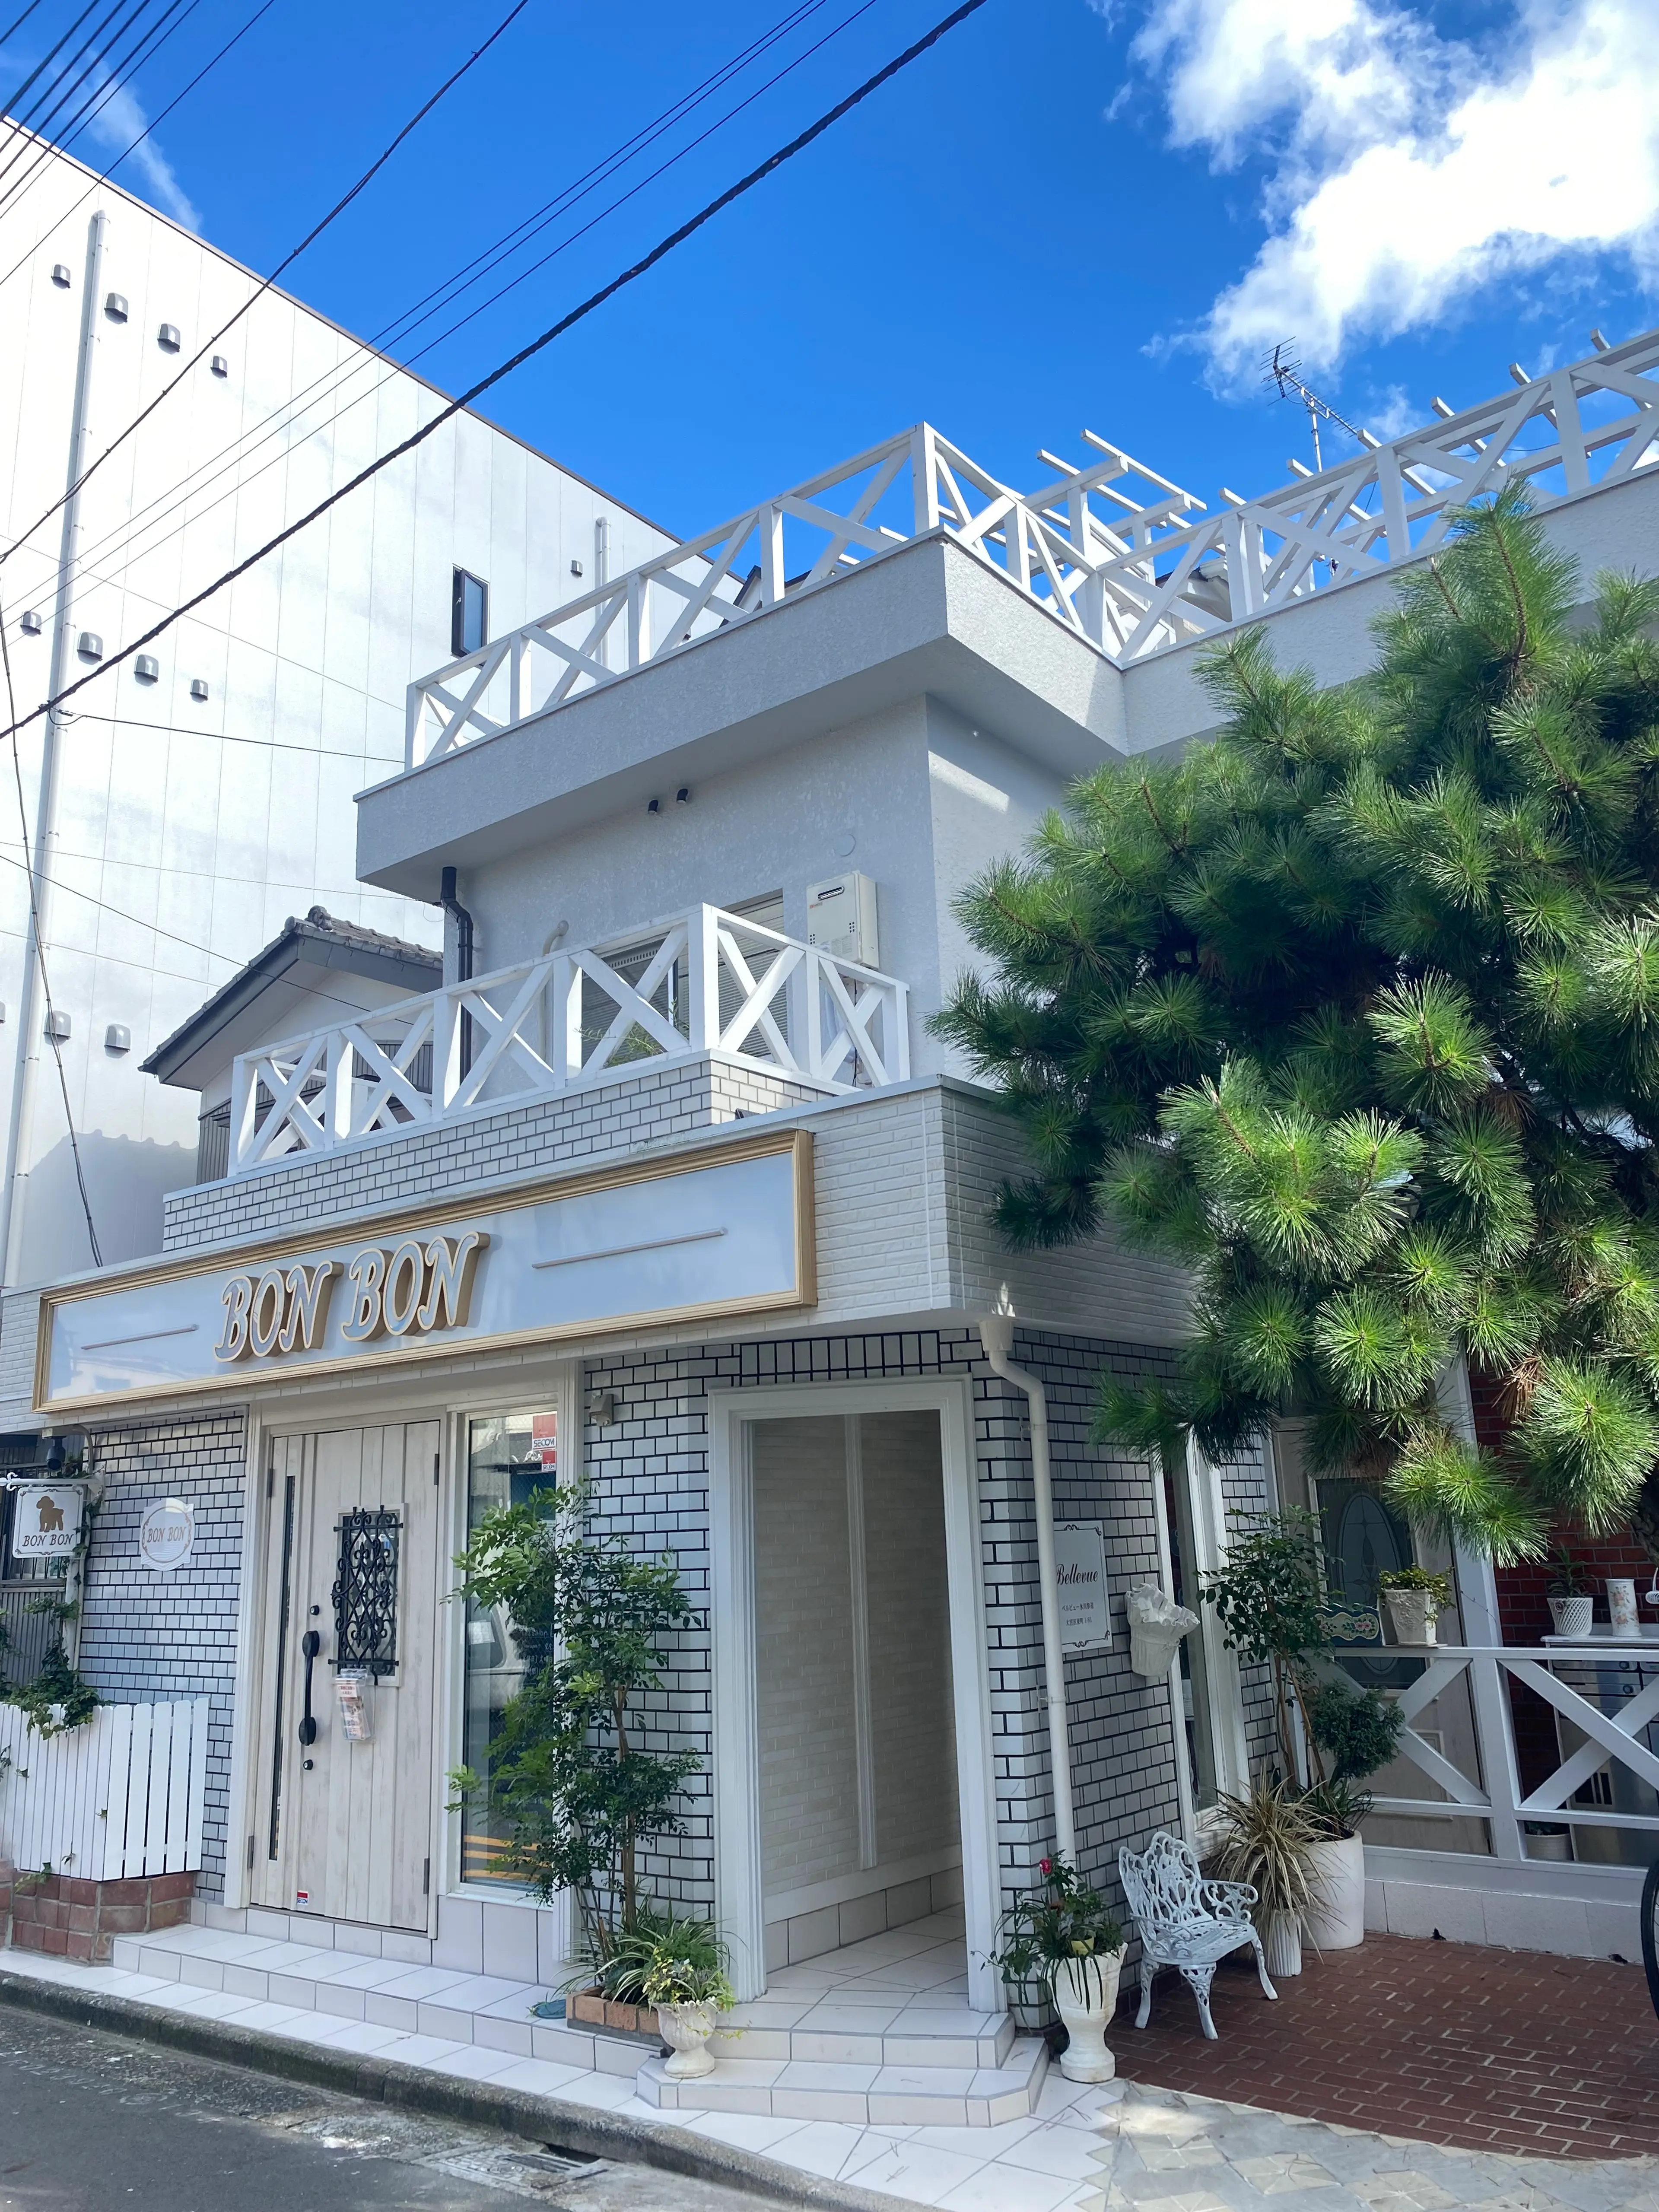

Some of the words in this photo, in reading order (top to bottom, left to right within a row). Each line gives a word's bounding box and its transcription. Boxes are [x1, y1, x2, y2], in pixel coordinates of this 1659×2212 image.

[215, 1260, 344, 1362] BON
[341, 1231, 489, 1341] BON
[534, 1438, 555, 1447] SECOM
[22, 1534, 48, 1547] BON
[49, 1534, 74, 1546] BON
[147, 1528, 165, 1543] BON
[167, 1526, 186, 1541] BON
[1056, 1563, 1098, 1585] Bellevue
